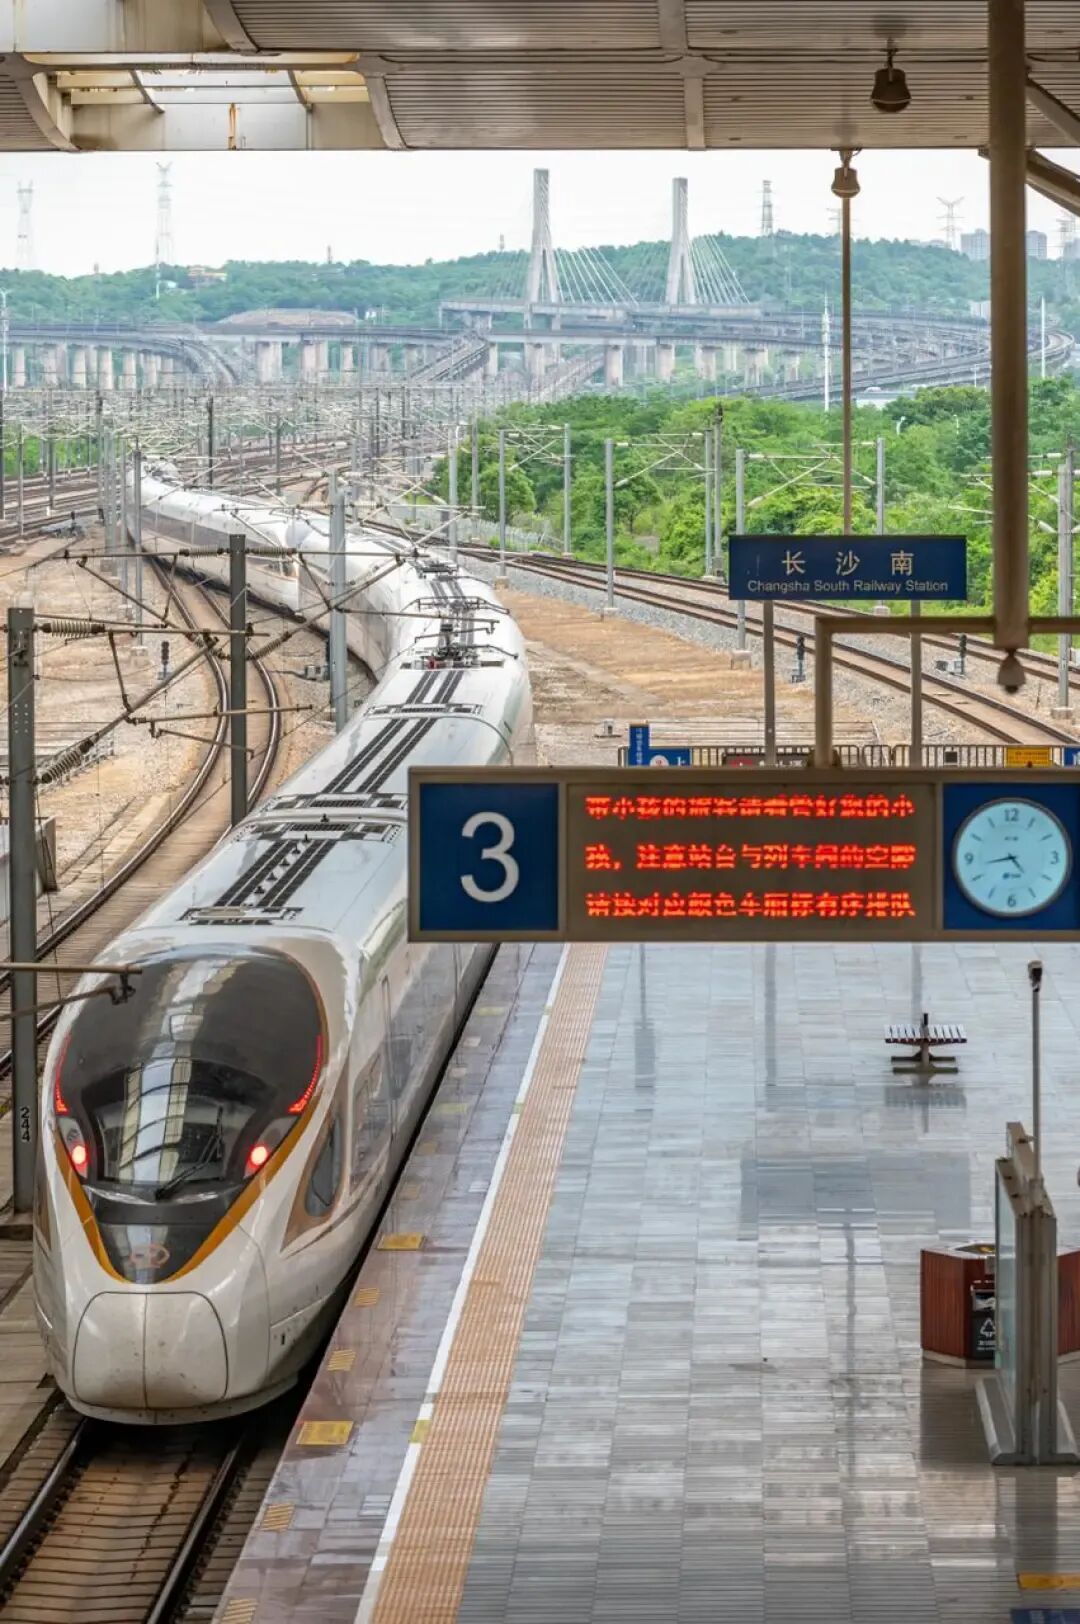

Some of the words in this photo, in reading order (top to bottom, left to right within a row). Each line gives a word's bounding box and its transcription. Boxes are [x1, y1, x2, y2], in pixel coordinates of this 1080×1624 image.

[782, 550, 914, 576] 长沙南
[747, 579, 810, 593] Changsha
[814, 579, 850, 591] South
[853, 579, 902, 593] Railway
[905, 579, 948, 591] Station
[1004, 807, 1020, 822] 12
[461, 811, 519, 903] 3
[964, 852, 974, 865] 9
[1050, 851, 1060, 865] 3
[1007, 894, 1017, 907] 6
[20, 1106, 31, 1142] 244
